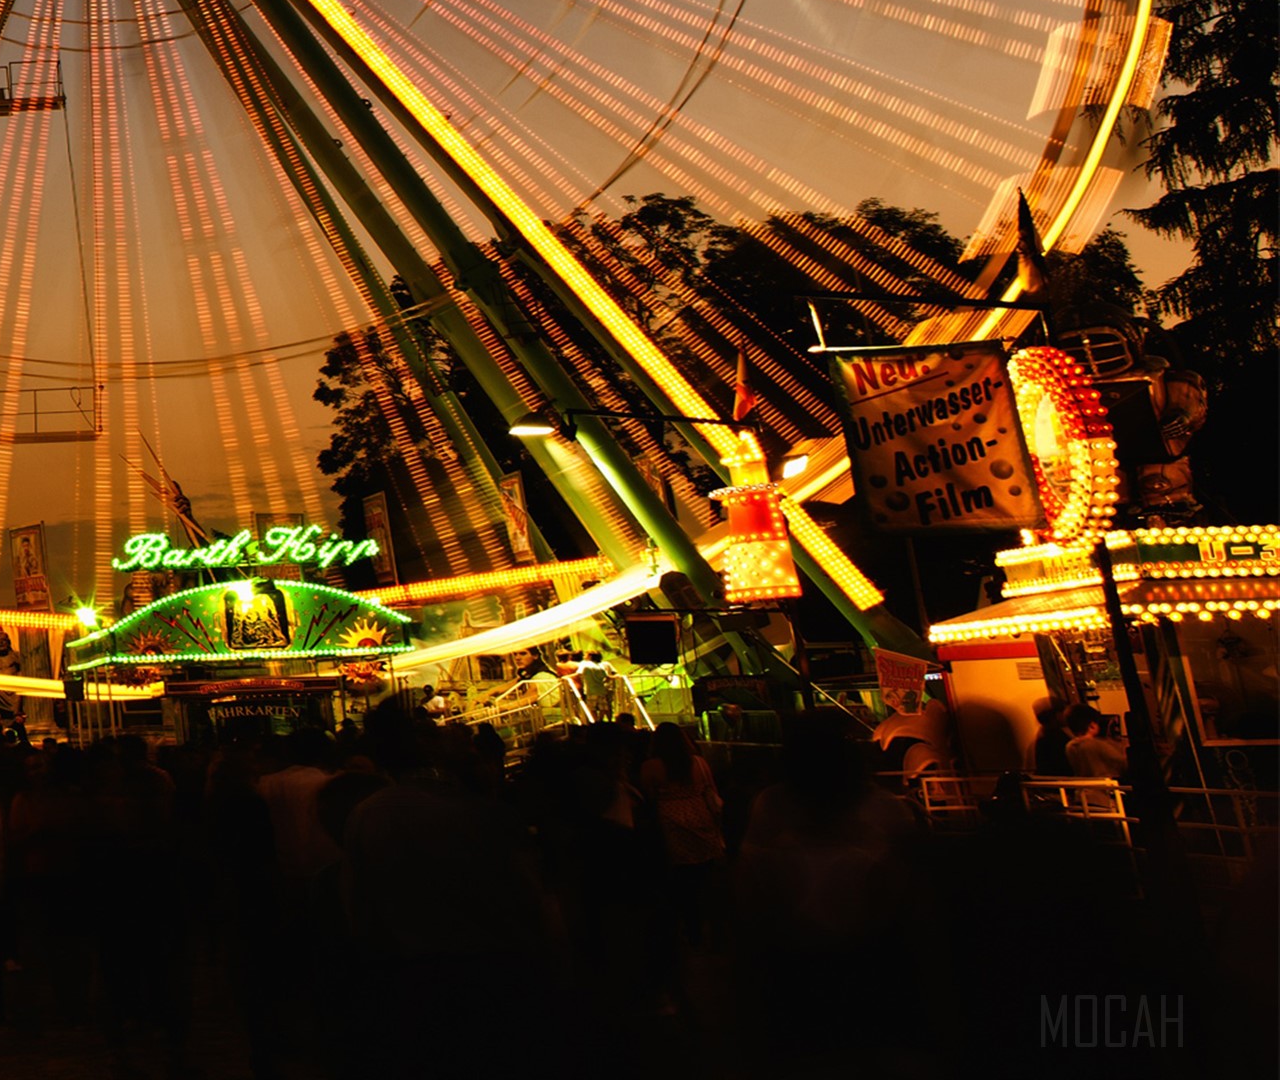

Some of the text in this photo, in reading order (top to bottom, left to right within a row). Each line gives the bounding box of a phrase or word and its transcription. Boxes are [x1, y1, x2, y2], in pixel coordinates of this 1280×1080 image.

[854, 377, 1002, 450] Unterwasser-
[894, 436, 997, 486] Action-
[915, 483, 993, 525] Film
[112, 529, 251, 571] Barth
[207, 703, 301, 720] FAHRKARTEN
